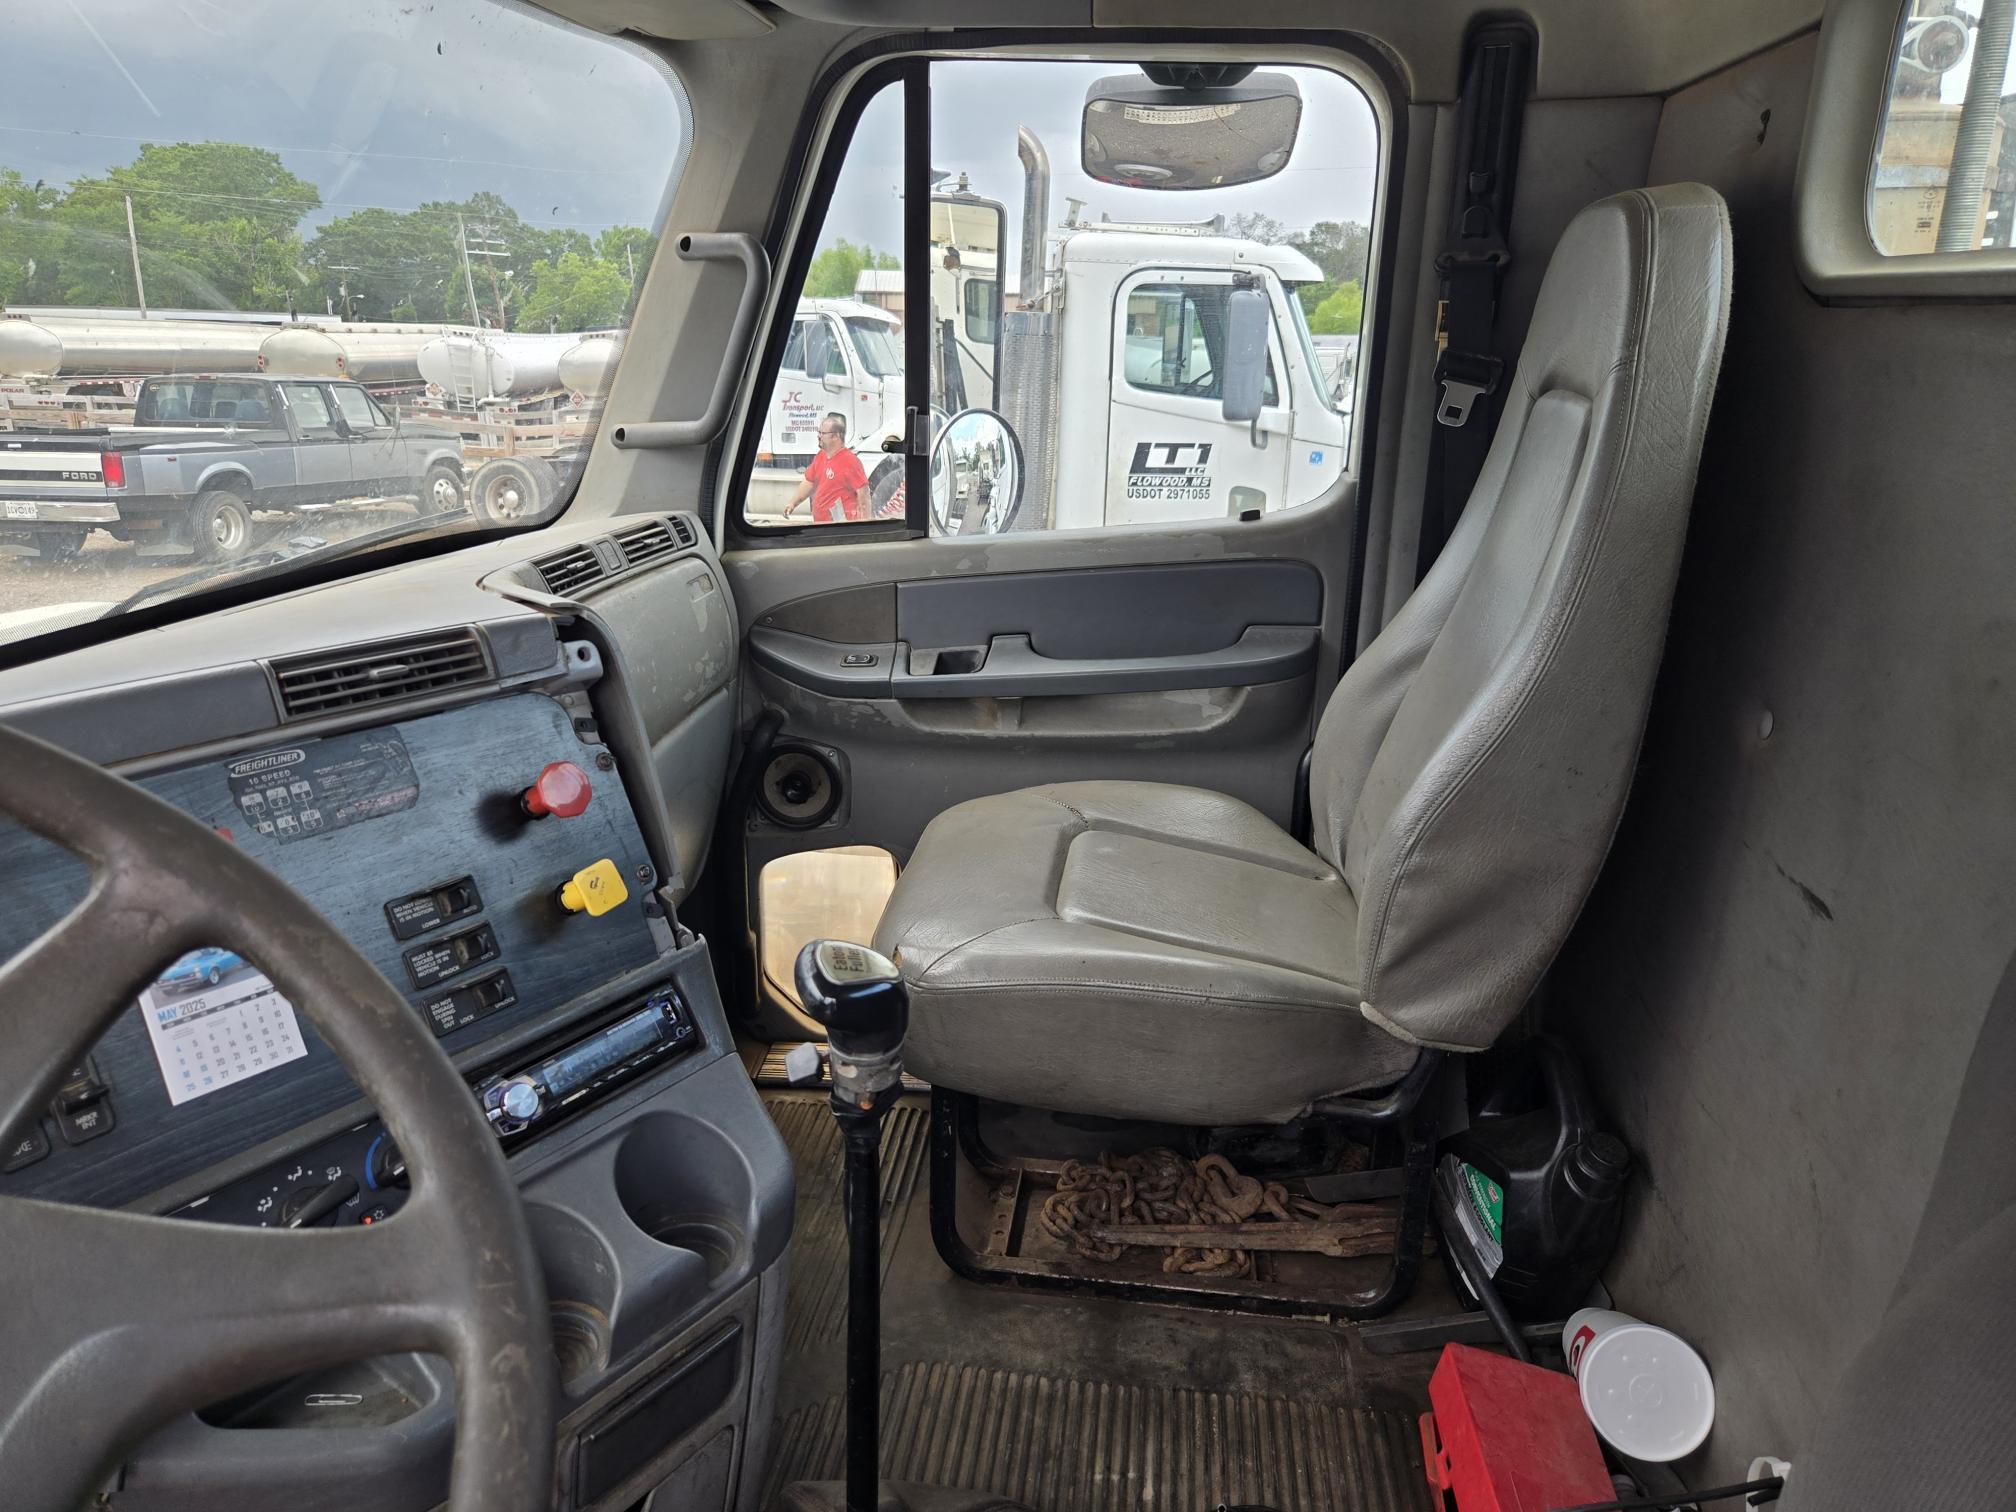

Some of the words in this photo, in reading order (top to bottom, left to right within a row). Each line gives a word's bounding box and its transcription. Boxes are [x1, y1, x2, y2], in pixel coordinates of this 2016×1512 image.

[781, 391, 802, 403] JC
[62, 472, 97, 480] FORD
[1185, 467, 1205, 475] LLC
[1128, 476, 1189, 487] FLOWOOD,
[1191, 477, 1211, 487] MS
[1127, 489, 1162, 499] USDOT
[1166, 489, 1210, 499] 2971055
[235, 752, 298, 774] FREIGHTLINER
[249, 777, 259, 785] 10
[261, 770, 290, 781] SPEED
[438, 965, 459, 977] UNLOCK
[158, 1009, 178, 1023] MAY
[179, 998, 206, 1015] 2025
[460, 1014, 474, 1023] LOCK
